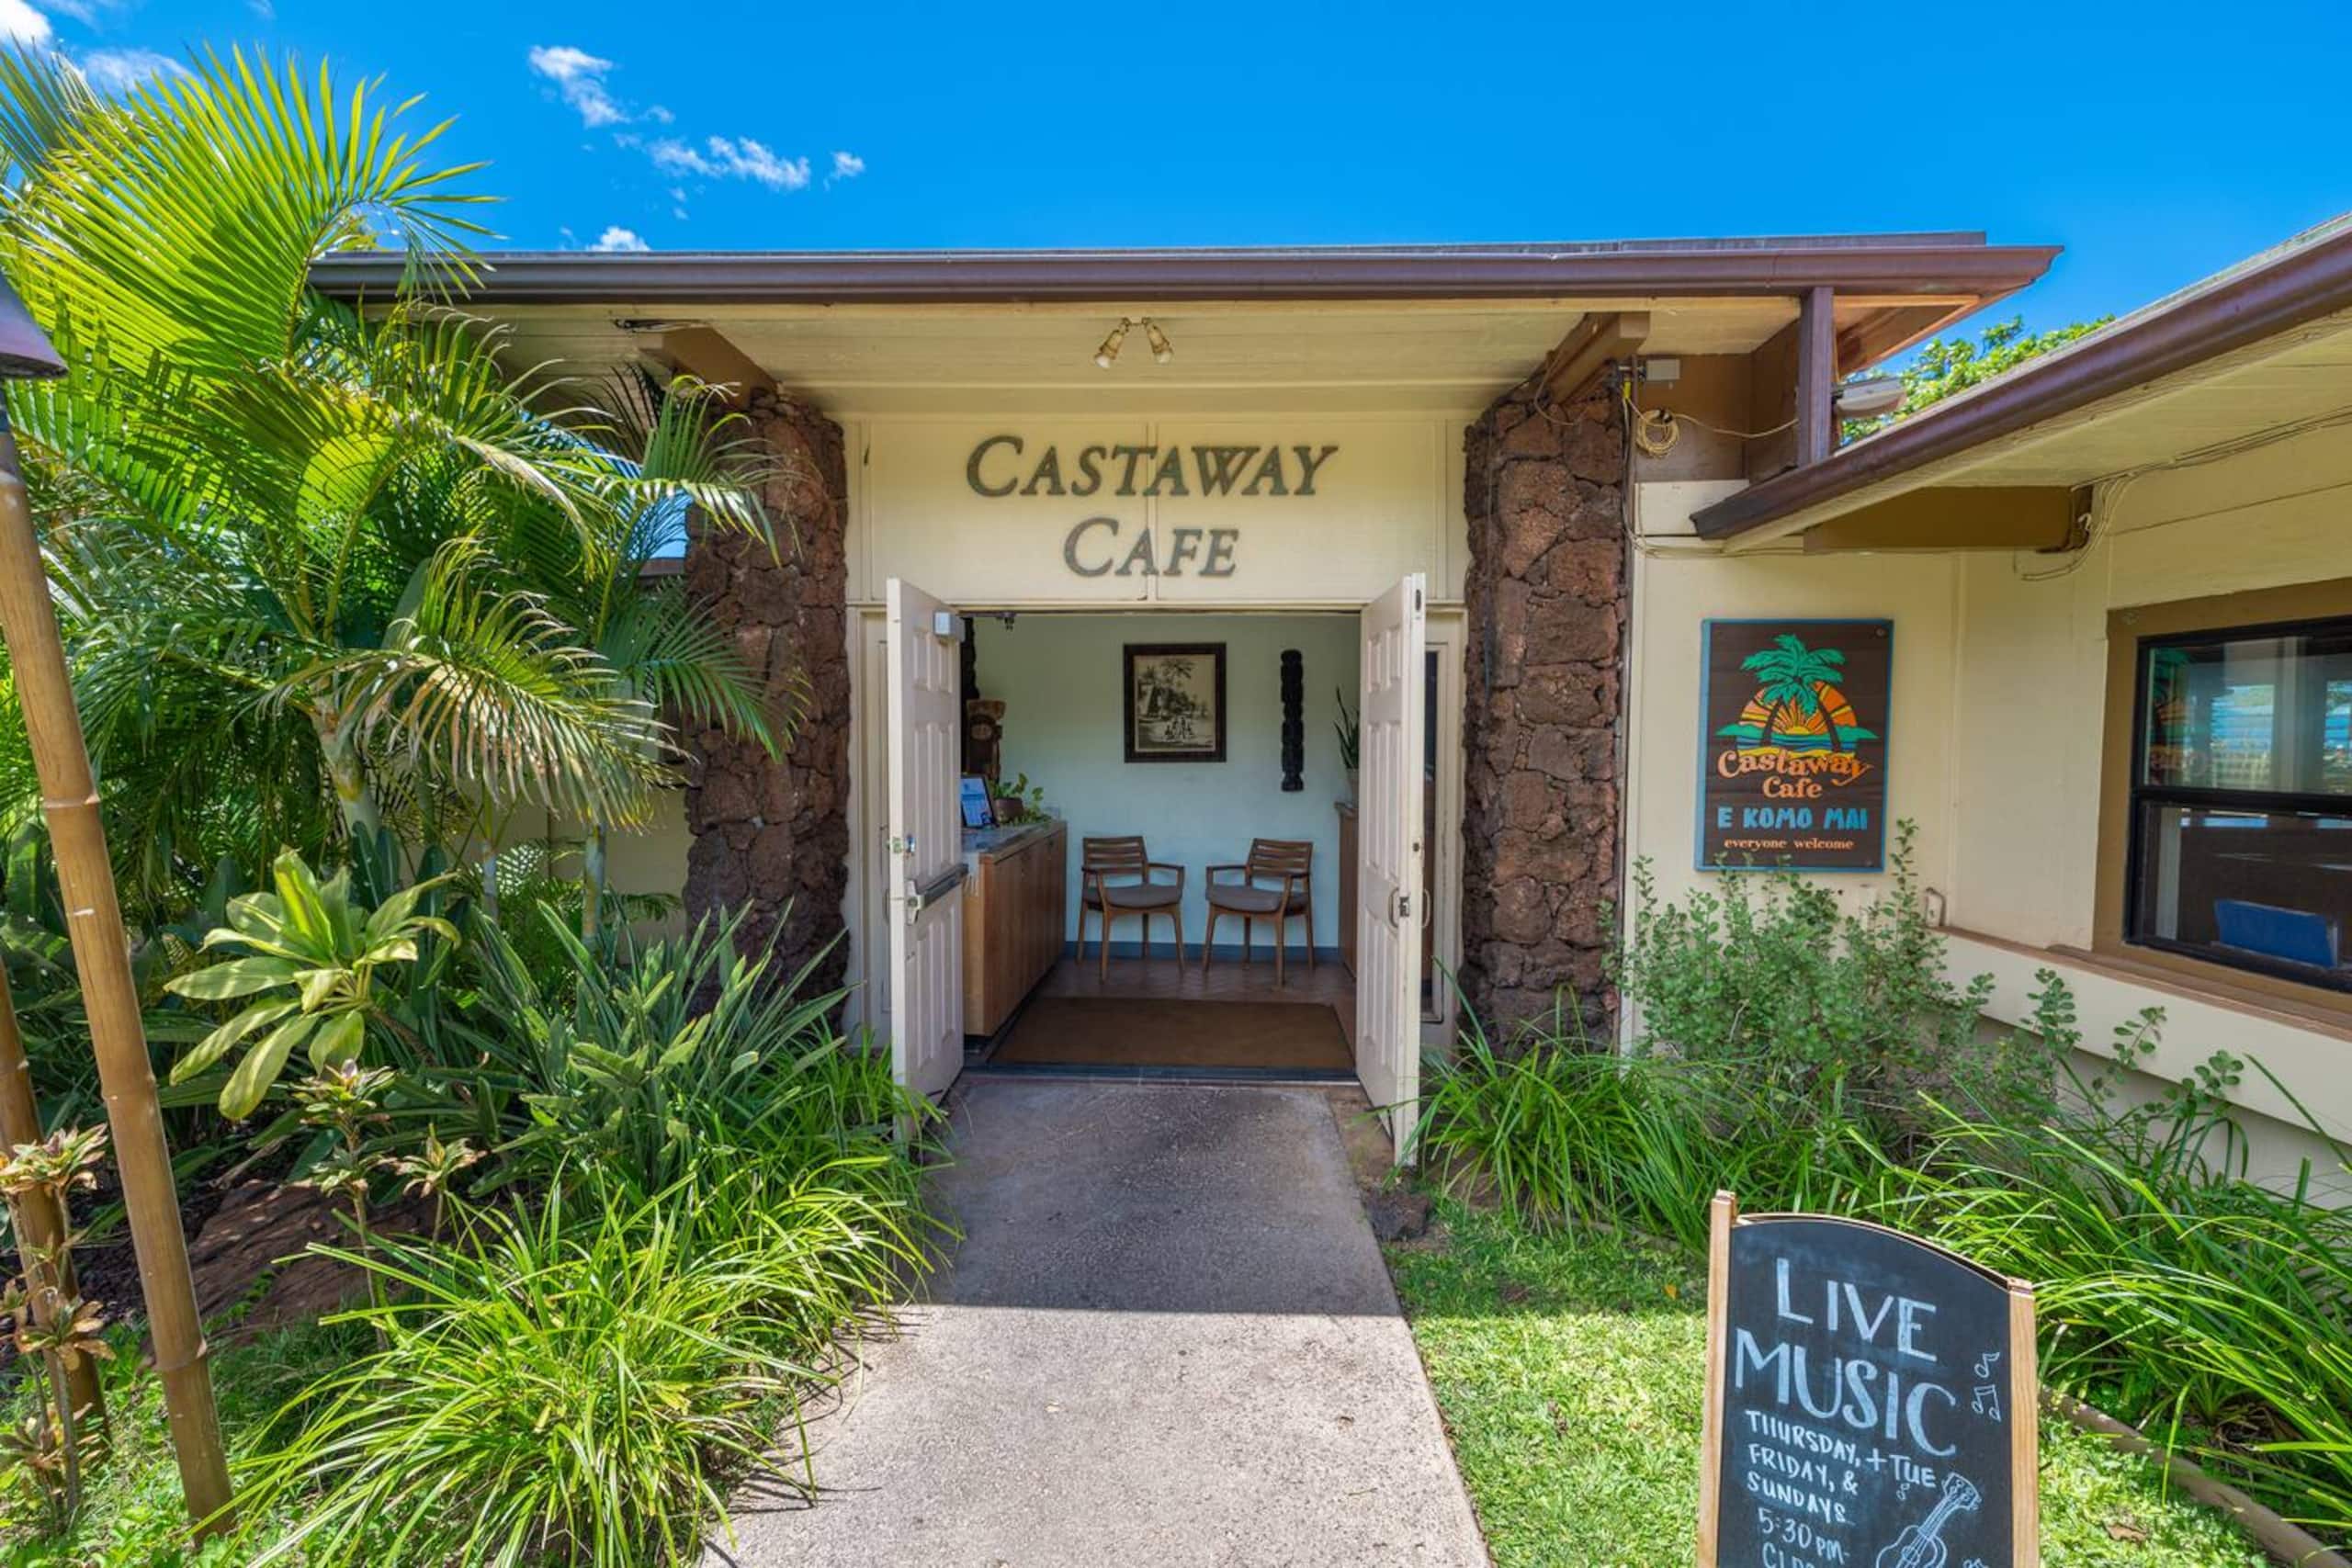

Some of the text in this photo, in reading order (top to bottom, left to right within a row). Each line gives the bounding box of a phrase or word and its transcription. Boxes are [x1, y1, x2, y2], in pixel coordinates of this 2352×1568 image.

[967, 435, 1339, 497] CASTAWAY
[1063, 517, 1239, 577] CAFE
[1717, 749, 1874, 786] Castaway
[1762, 776, 1824, 799] Cafe
[1717, 807, 1868, 831] E KOMO MAI
[1724, 837, 1855, 852] everyone welcome
[1776, 1258, 1937, 1362] LIVE
[1735, 1327, 1957, 1457] MUSIC
[1746, 1408, 1861, 1468] THURSDAY,
[1889, 1453, 1937, 1488] TUE
[1748, 1443, 1859, 1495] FRIDAY, &
[1747, 1472, 1847, 1524] SUNDAYS
[1758, 1506, 1813, 1549] 5:30
